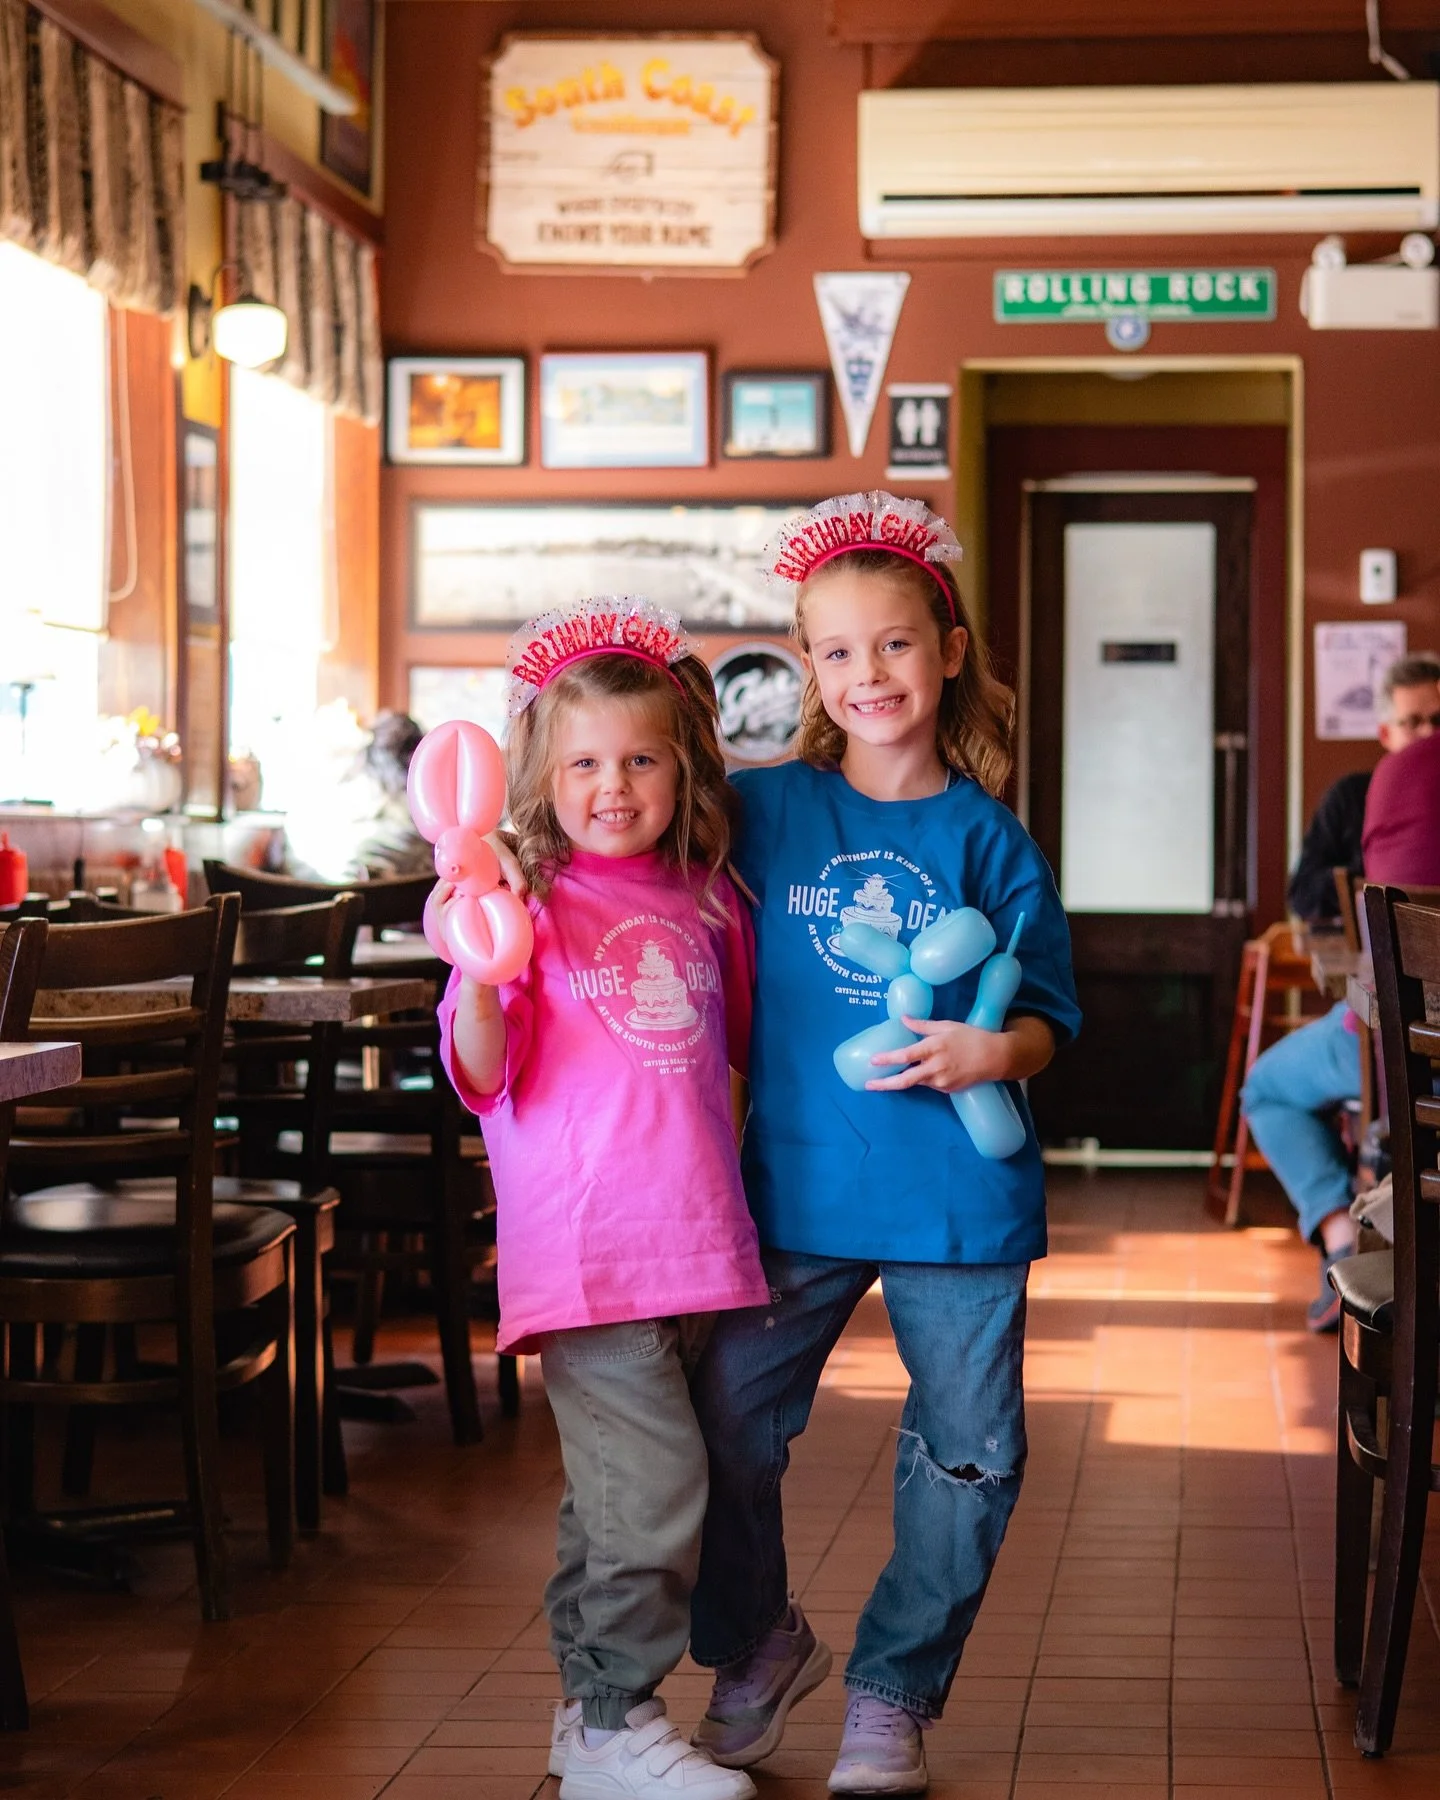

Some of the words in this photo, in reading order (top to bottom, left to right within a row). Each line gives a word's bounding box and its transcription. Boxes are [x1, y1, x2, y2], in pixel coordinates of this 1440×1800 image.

[1004, 272, 1152, 303] ROLLING
[1168, 271, 1262, 302] ROCK
[773, 511, 874, 583] BIRTHDAY
[880, 513, 939, 553] GIRL
[512, 612, 618, 687] BIRTHDAY
[622, 614, 681, 656] GIRL
[830, 850, 881, 867] BIRTHDAY
[884, 851, 894, 860] IS
[896, 855, 921, 874] KIND
[819, 864, 831, 881] MY
[920, 873, 933, 888] OF
[787, 884, 840, 918] HUGE
[926, 888, 937, 897] A
[594, 944, 607, 962] MY
[602, 915, 645, 946] BIRTHDAY
[648, 915, 658, 924] IS
[659, 918, 682, 934] KIND
[683, 933, 695, 947] OF
[808, 923, 818, 936] AT
[812, 936, 825, 956] THE
[822, 953, 850, 979] SOUTH
[568, 965, 628, 1001] HUGE
[685, 961, 719, 993] DEAL
[851, 972, 882, 984] COAST
[835, 986, 860, 996] CRYSTAL
[848, 997, 861, 1005] EST.
[598, 1005, 610, 1018] AT
[607, 1015, 623, 1035] THE
[623, 1031, 655, 1050] SOUTH
[658, 1041, 687, 1052] COAST
